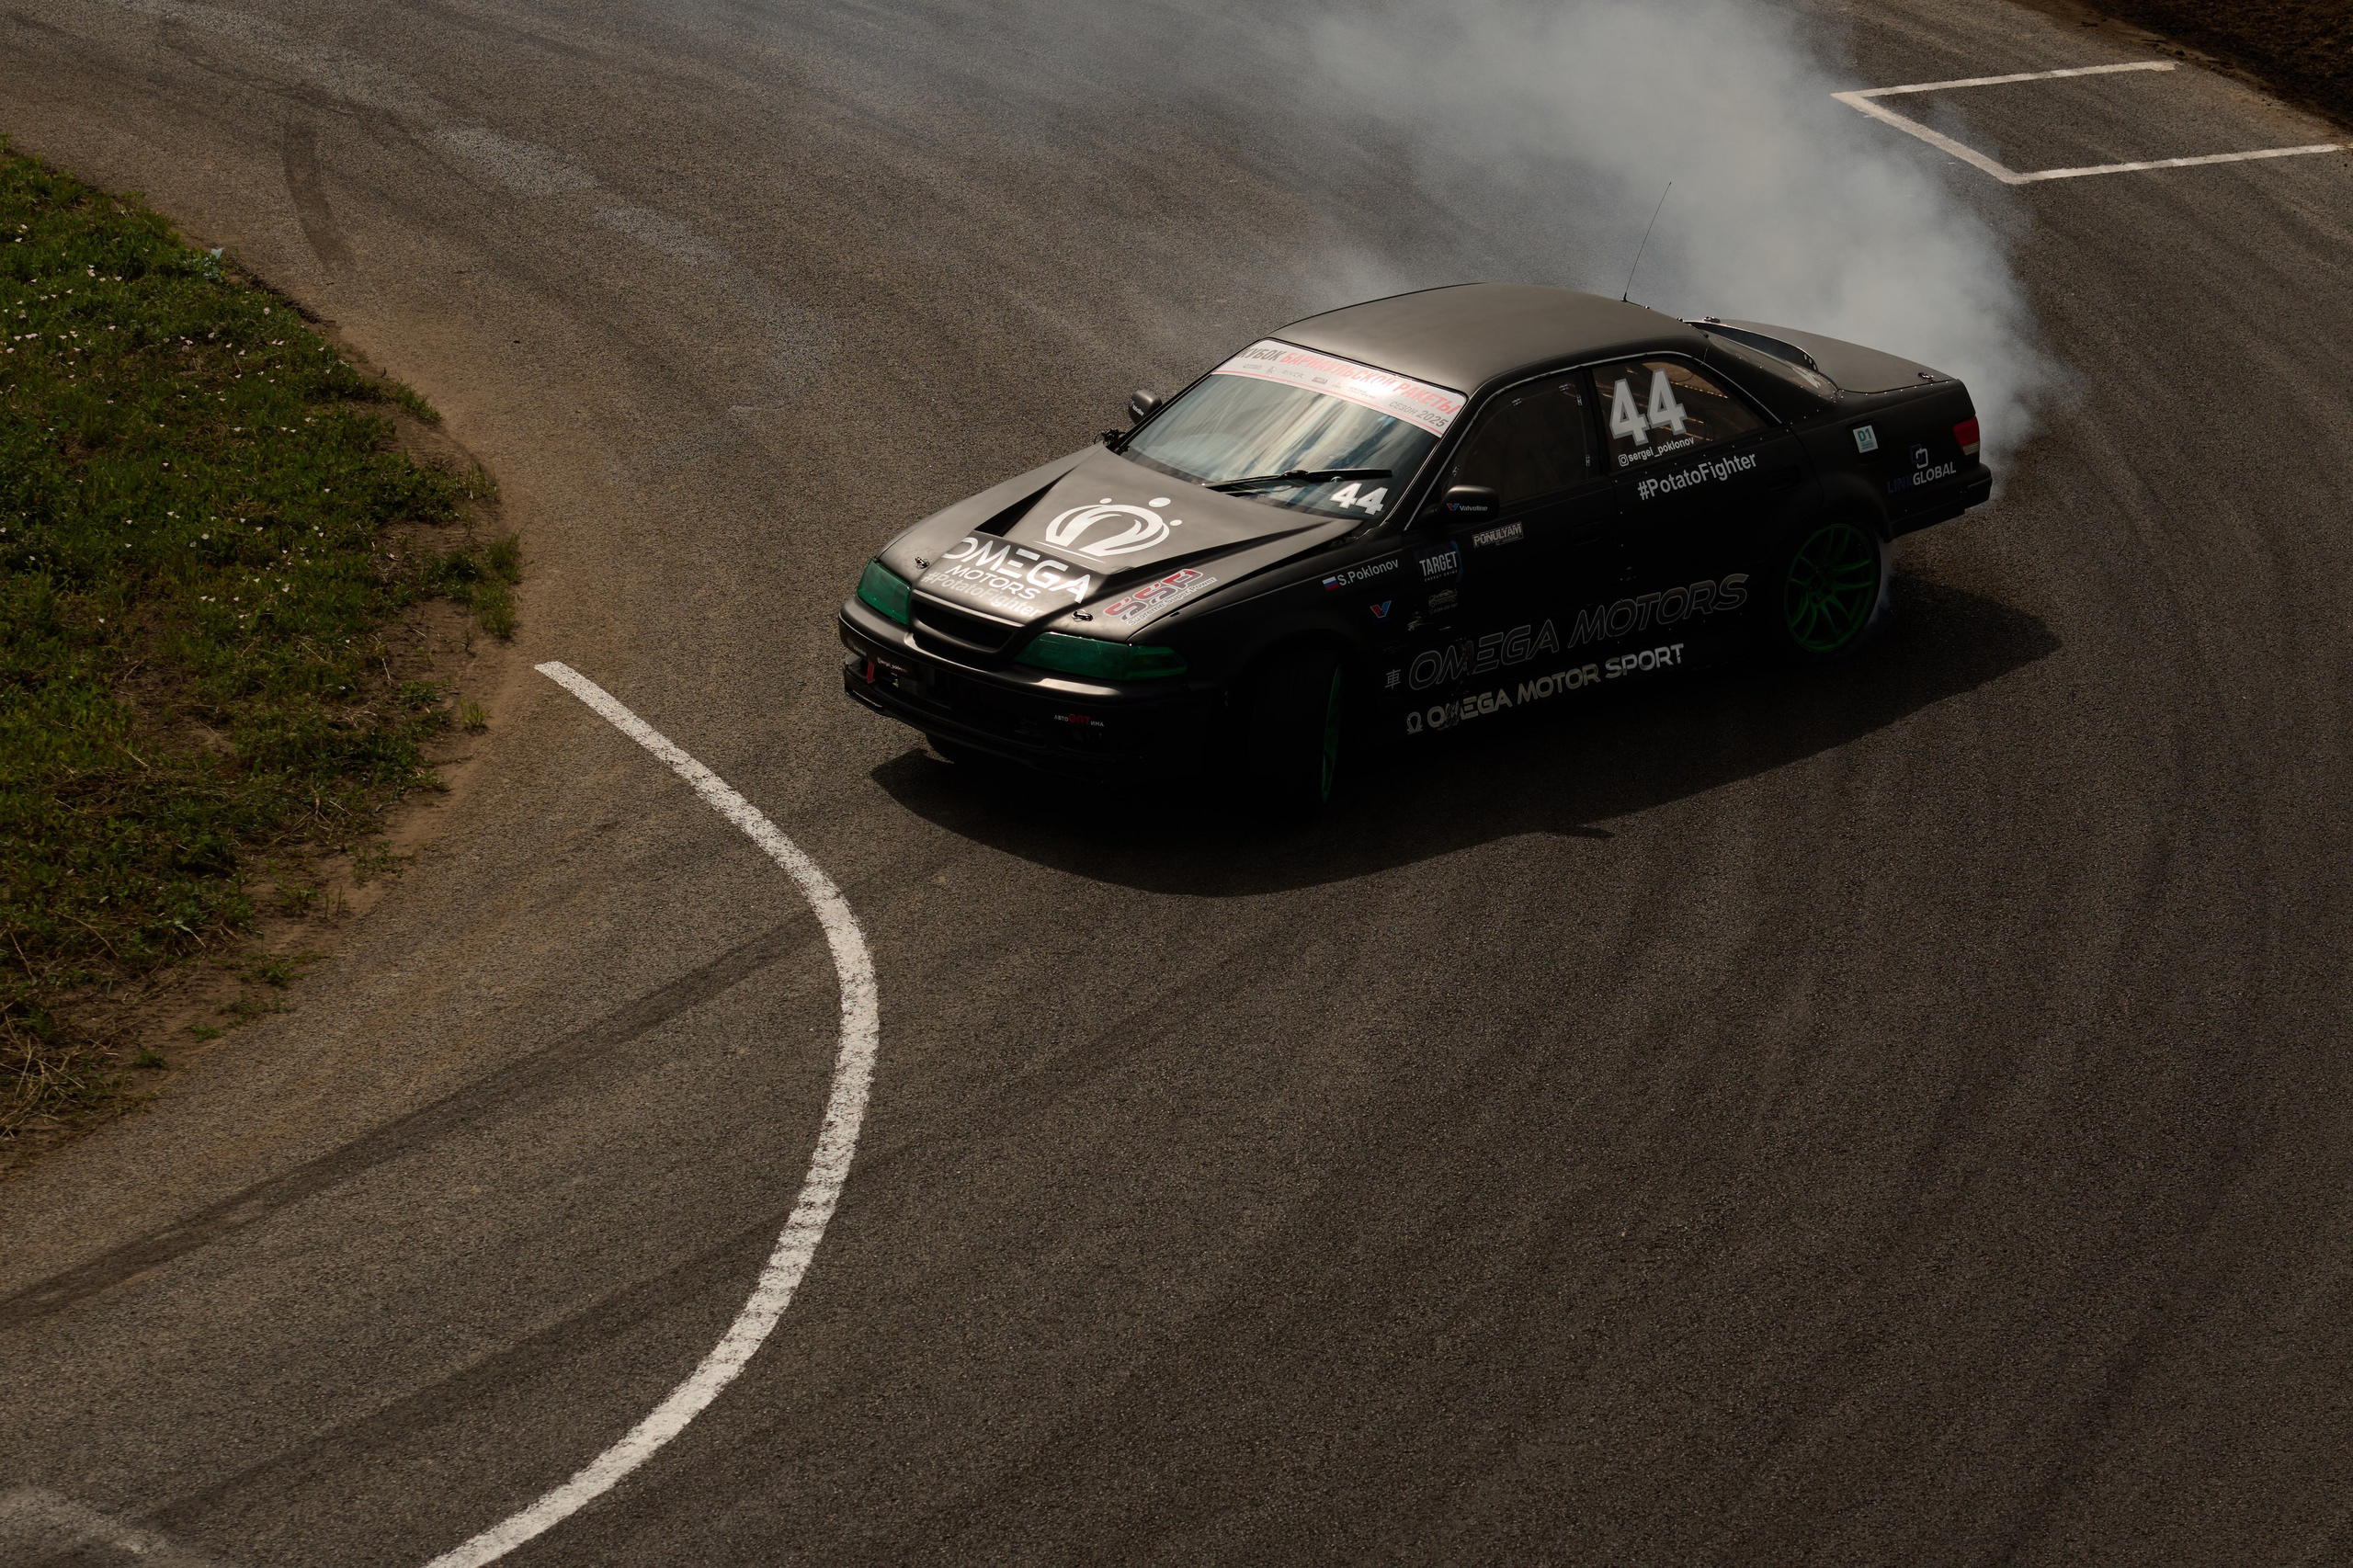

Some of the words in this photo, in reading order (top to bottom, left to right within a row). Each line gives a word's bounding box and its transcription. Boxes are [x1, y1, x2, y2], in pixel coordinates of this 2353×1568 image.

[1389, 401, 1418, 415] СЕЗОН
[1416, 410, 1449, 428] 2025
[1392, 382, 1462, 415] РАКЕТЫ
[1609, 368, 1688, 446] 44
[1857, 427, 1872, 442] D1
[1636, 452, 1757, 502] #PotatoFighter
[1329, 482, 1389, 516] 44
[1472, 521, 1522, 548] PONULYAM
[941, 537, 1091, 606] OMEGA
[1337, 556, 1400, 588] S.Poklonov
[1419, 551, 1458, 576] TARGET
[921, 570, 1042, 619] #PotatoFighter
[945, 564, 1041, 602] MOTORS
[1408, 619, 1560, 691] OMEGA
[1566, 573, 1750, 651] MOTORS
[1384, 668, 1402, 689] 車
[1517, 662, 1601, 706] MOTOR
[1603, 642, 1686, 681] SPORT
